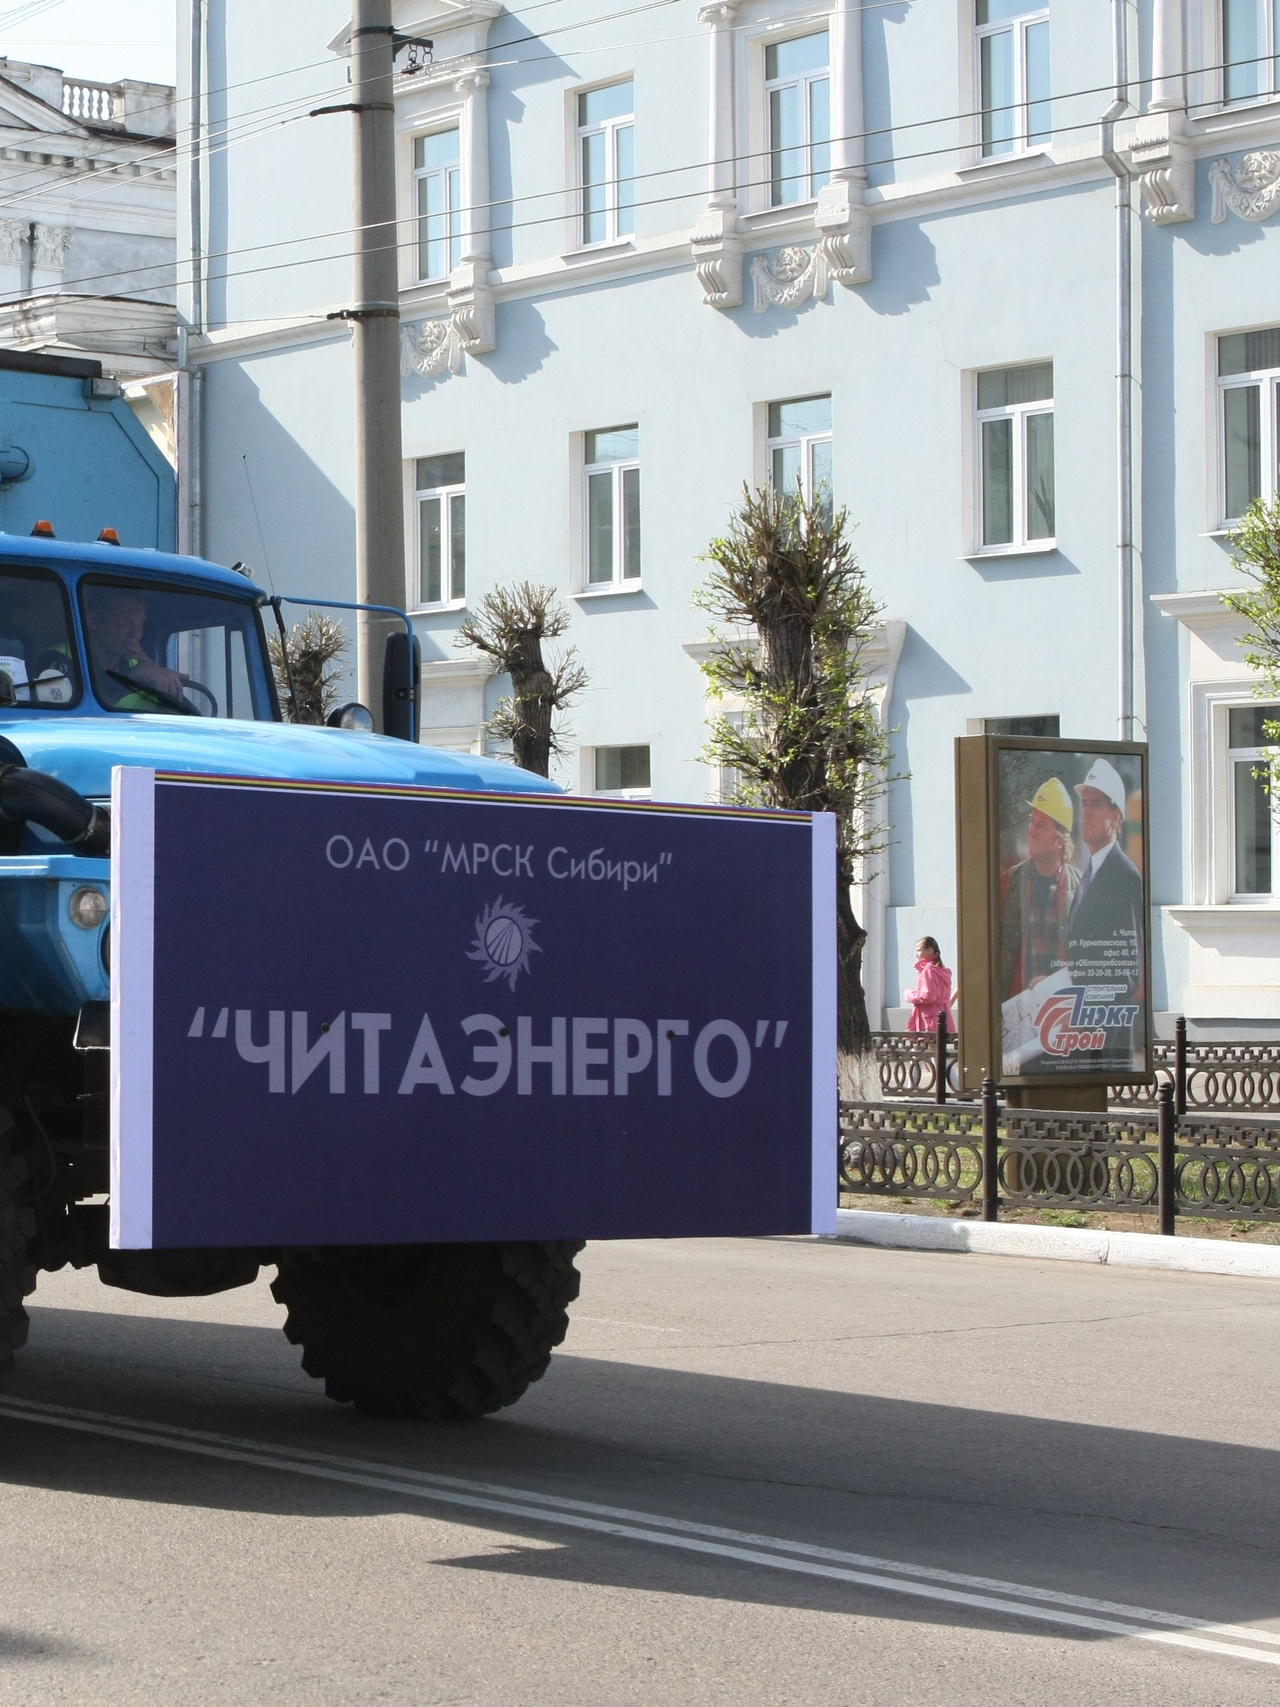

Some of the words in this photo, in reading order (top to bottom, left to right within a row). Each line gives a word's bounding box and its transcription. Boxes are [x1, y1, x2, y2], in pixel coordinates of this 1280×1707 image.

[326, 834, 410, 871] ОАО
[424, 839, 534, 878] "МРСК
[547, 846, 673, 891] Сибири"
[187, 1006, 789, 1098] "ЧИТАЭНЕРГО"
